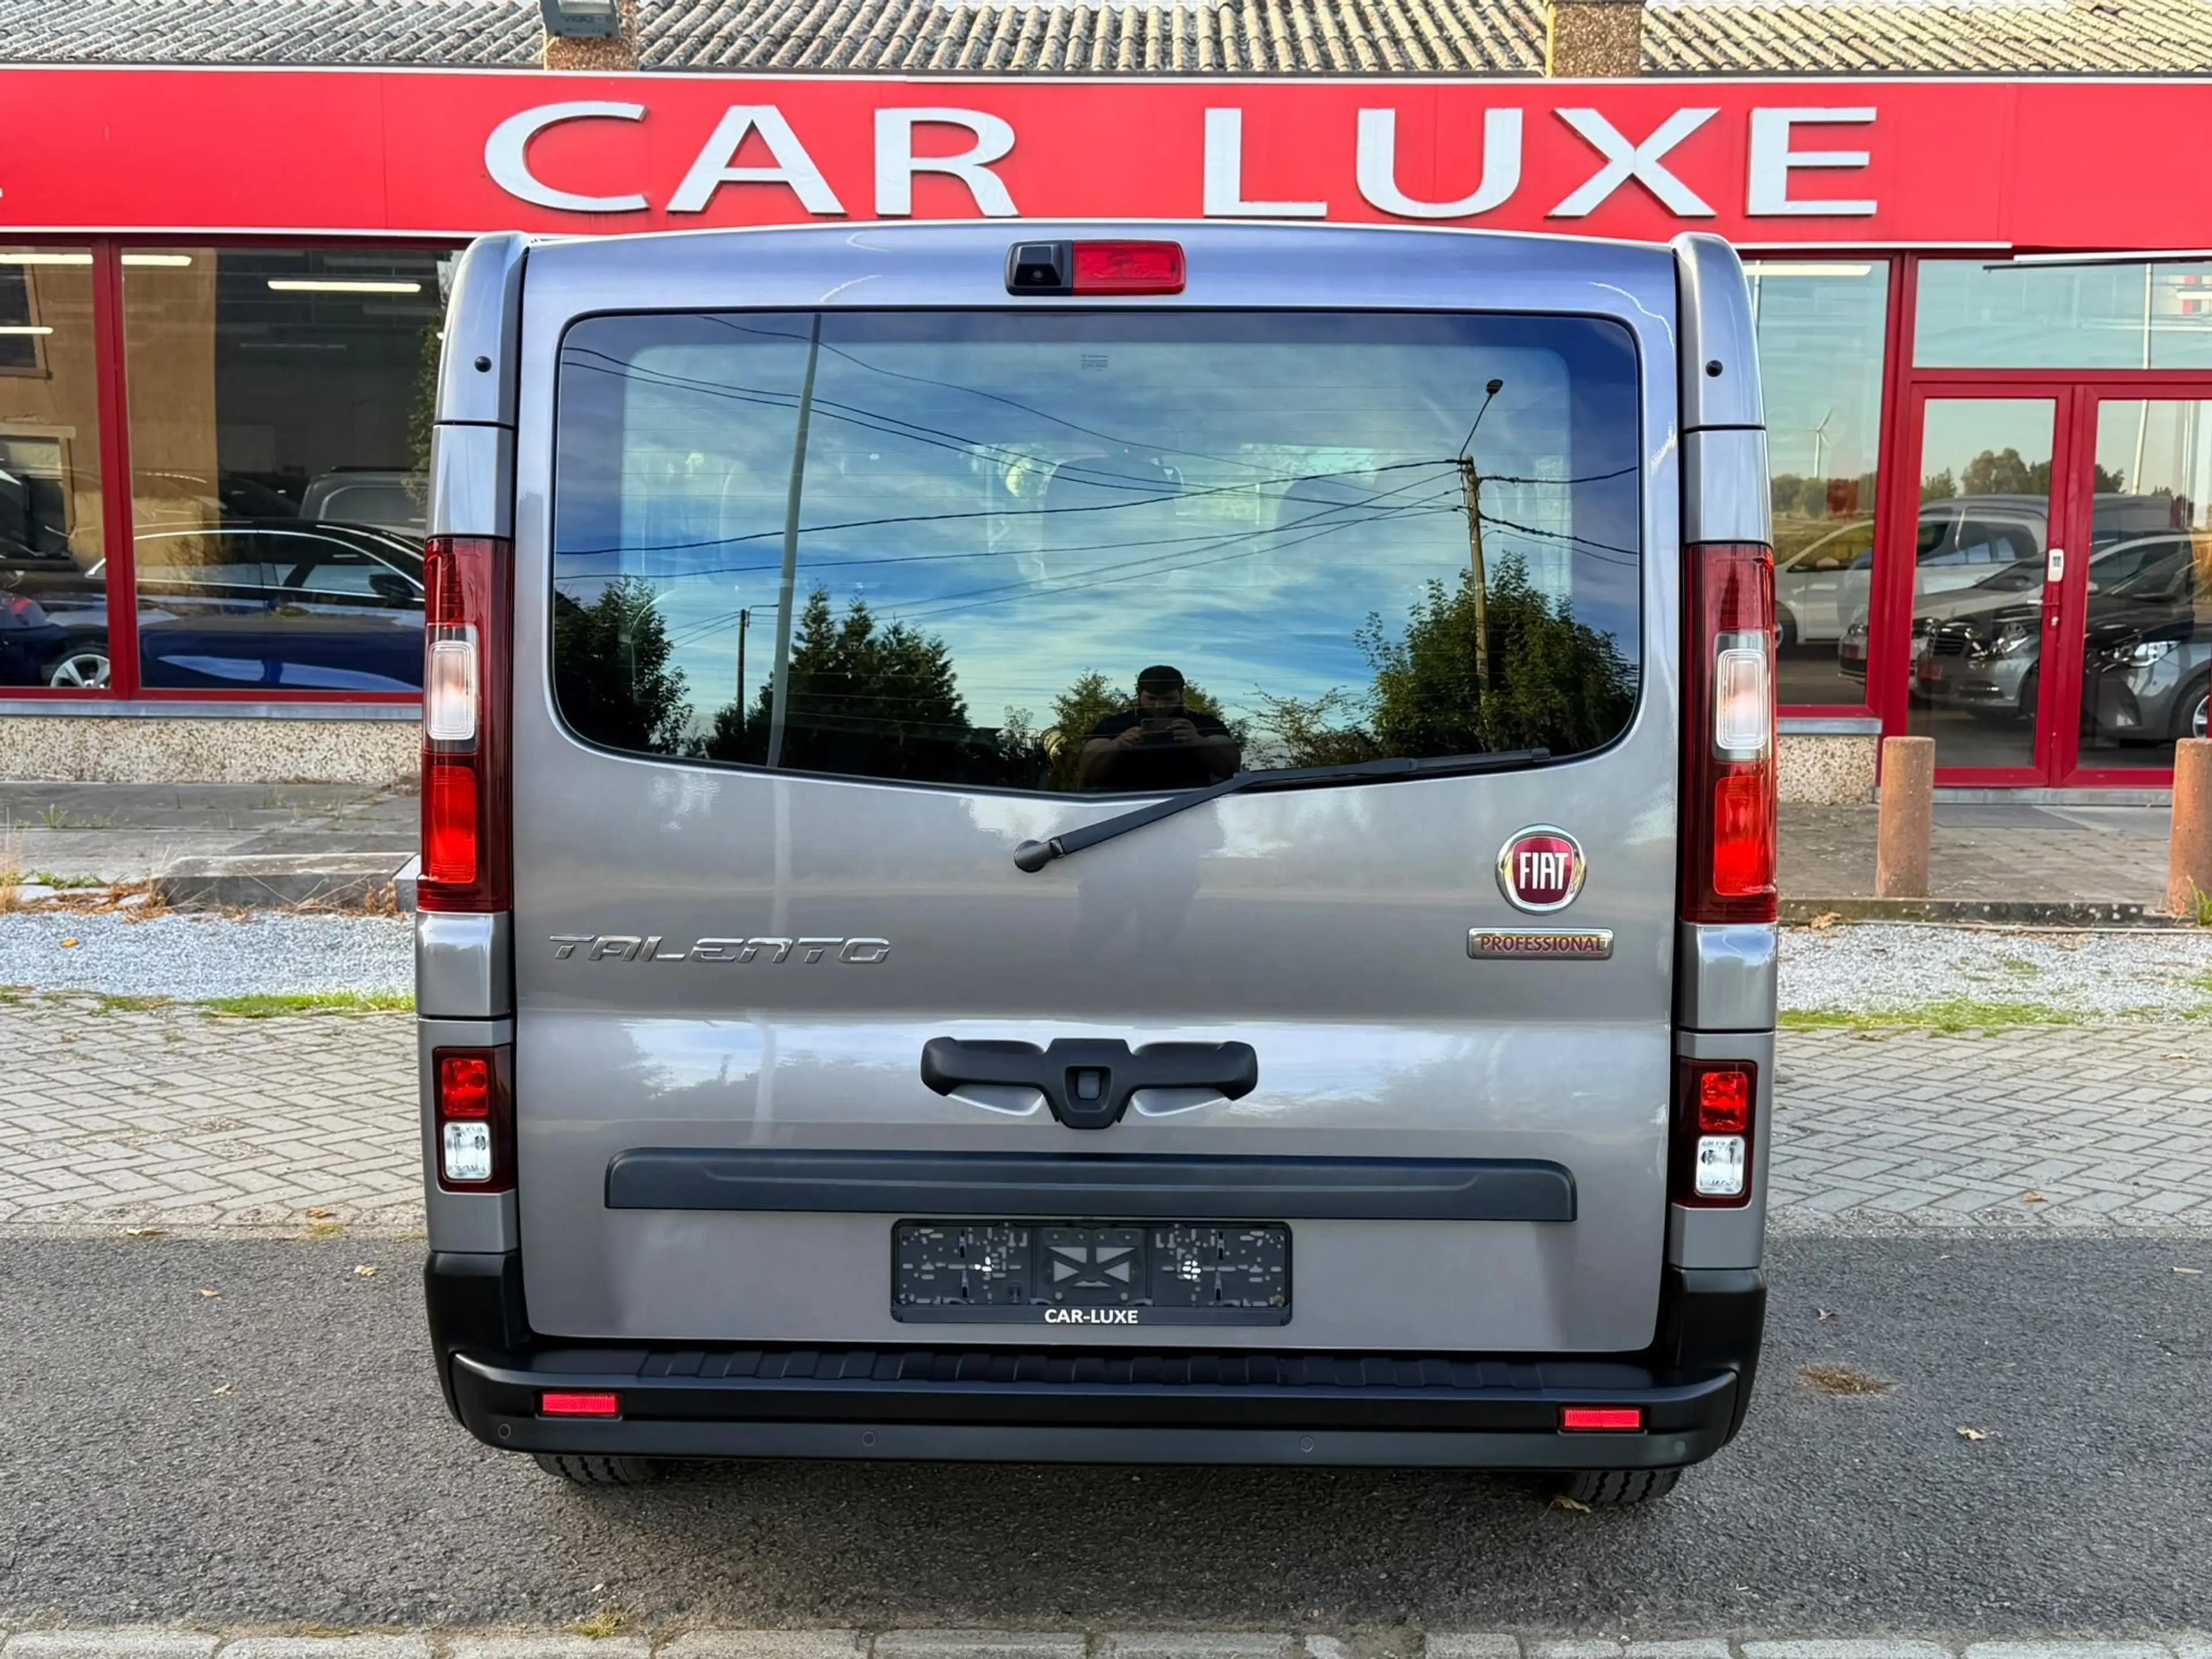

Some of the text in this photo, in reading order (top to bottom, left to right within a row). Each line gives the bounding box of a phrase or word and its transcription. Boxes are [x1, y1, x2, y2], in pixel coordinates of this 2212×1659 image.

[484, 101, 1877, 218] CAR LUXE
[1519, 851, 1569, 889] FIAT
[548, 934, 891, 964] TALENTO
[1480, 936, 1604, 952] PROFESSIONAL
[1044, 1308, 1139, 1324] CAR-LUXE
